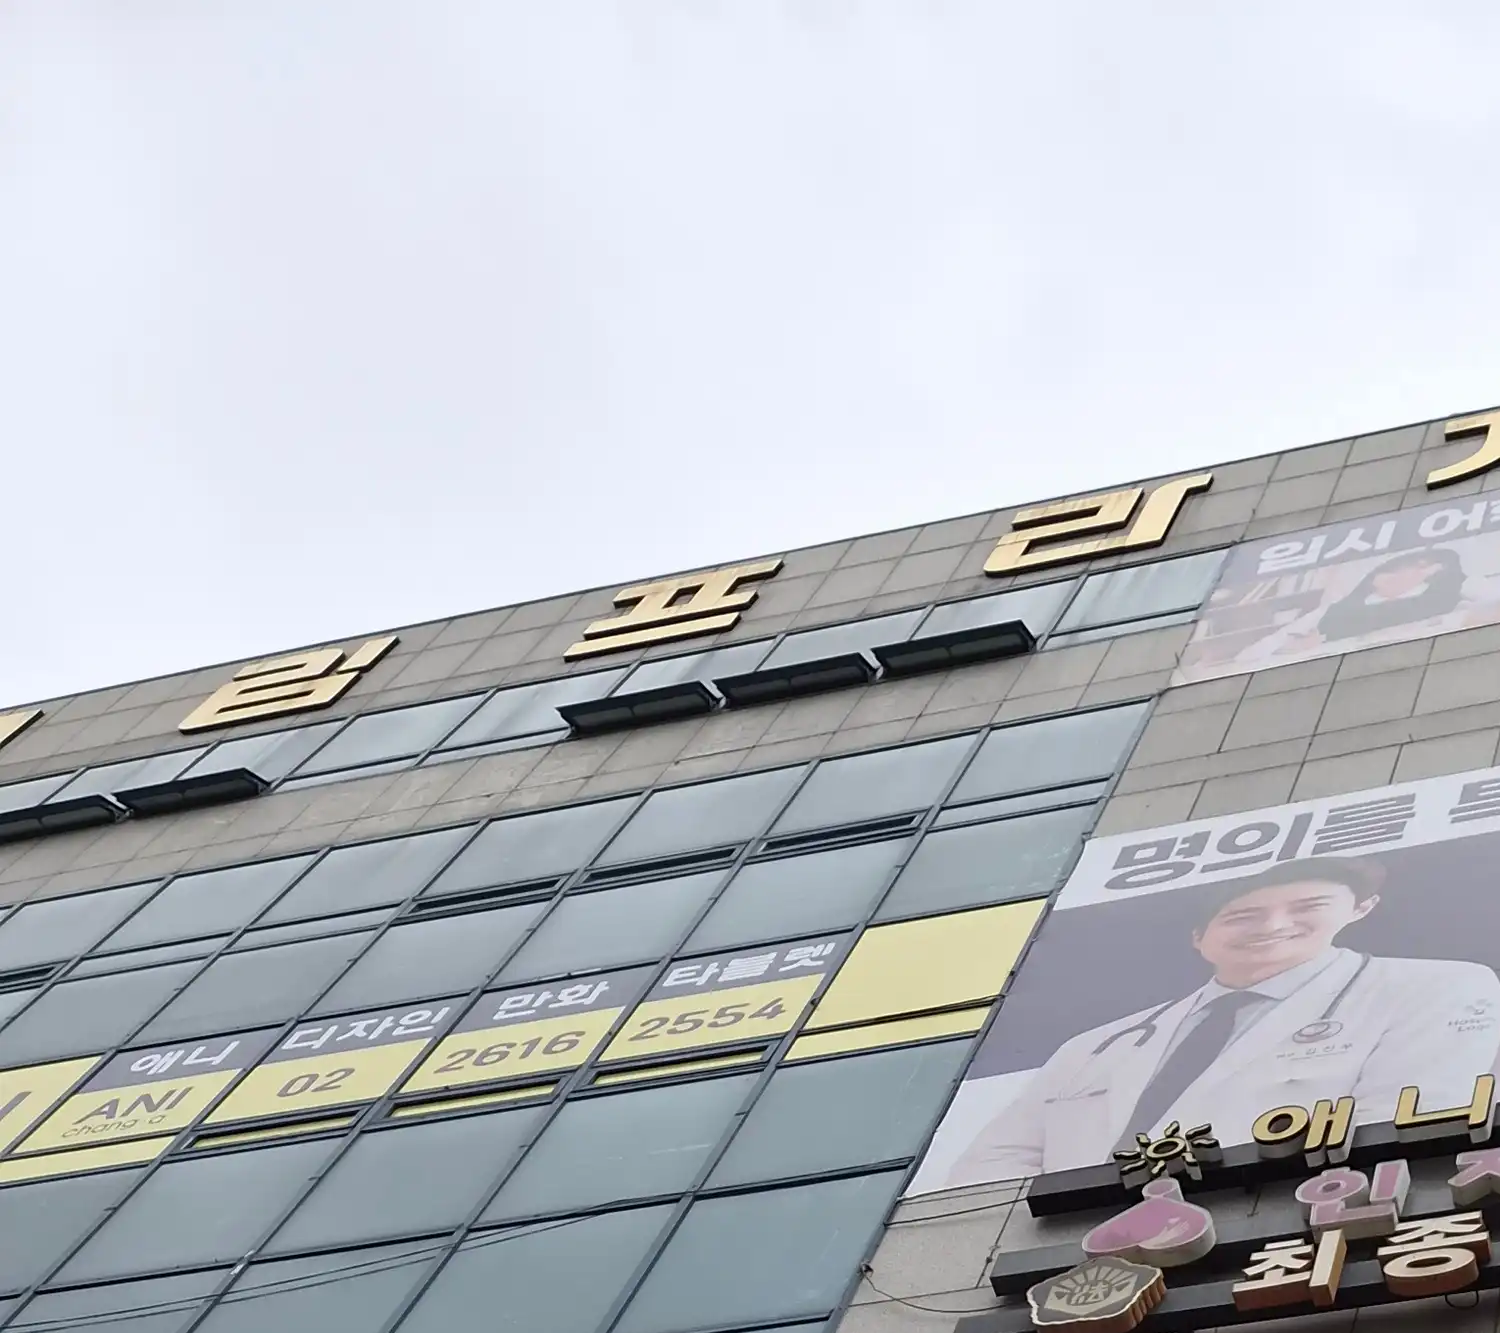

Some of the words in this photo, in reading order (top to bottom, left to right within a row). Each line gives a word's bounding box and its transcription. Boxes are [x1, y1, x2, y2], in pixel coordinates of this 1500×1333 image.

[1256, 521, 1397, 576] 입시
[1104, 793, 1417, 891] 명의를
[130, 1041, 240, 1075] 애니
[282, 1007, 450, 1049] 디자인
[493, 980, 611, 1020] 만화
[662, 942, 836, 989] 타블렛
[277, 1068, 356, 1098] 02
[433, 1031, 586, 1075] 2616
[627, 997, 787, 1041] 2554
[74, 1087, 194, 1124] ANI
